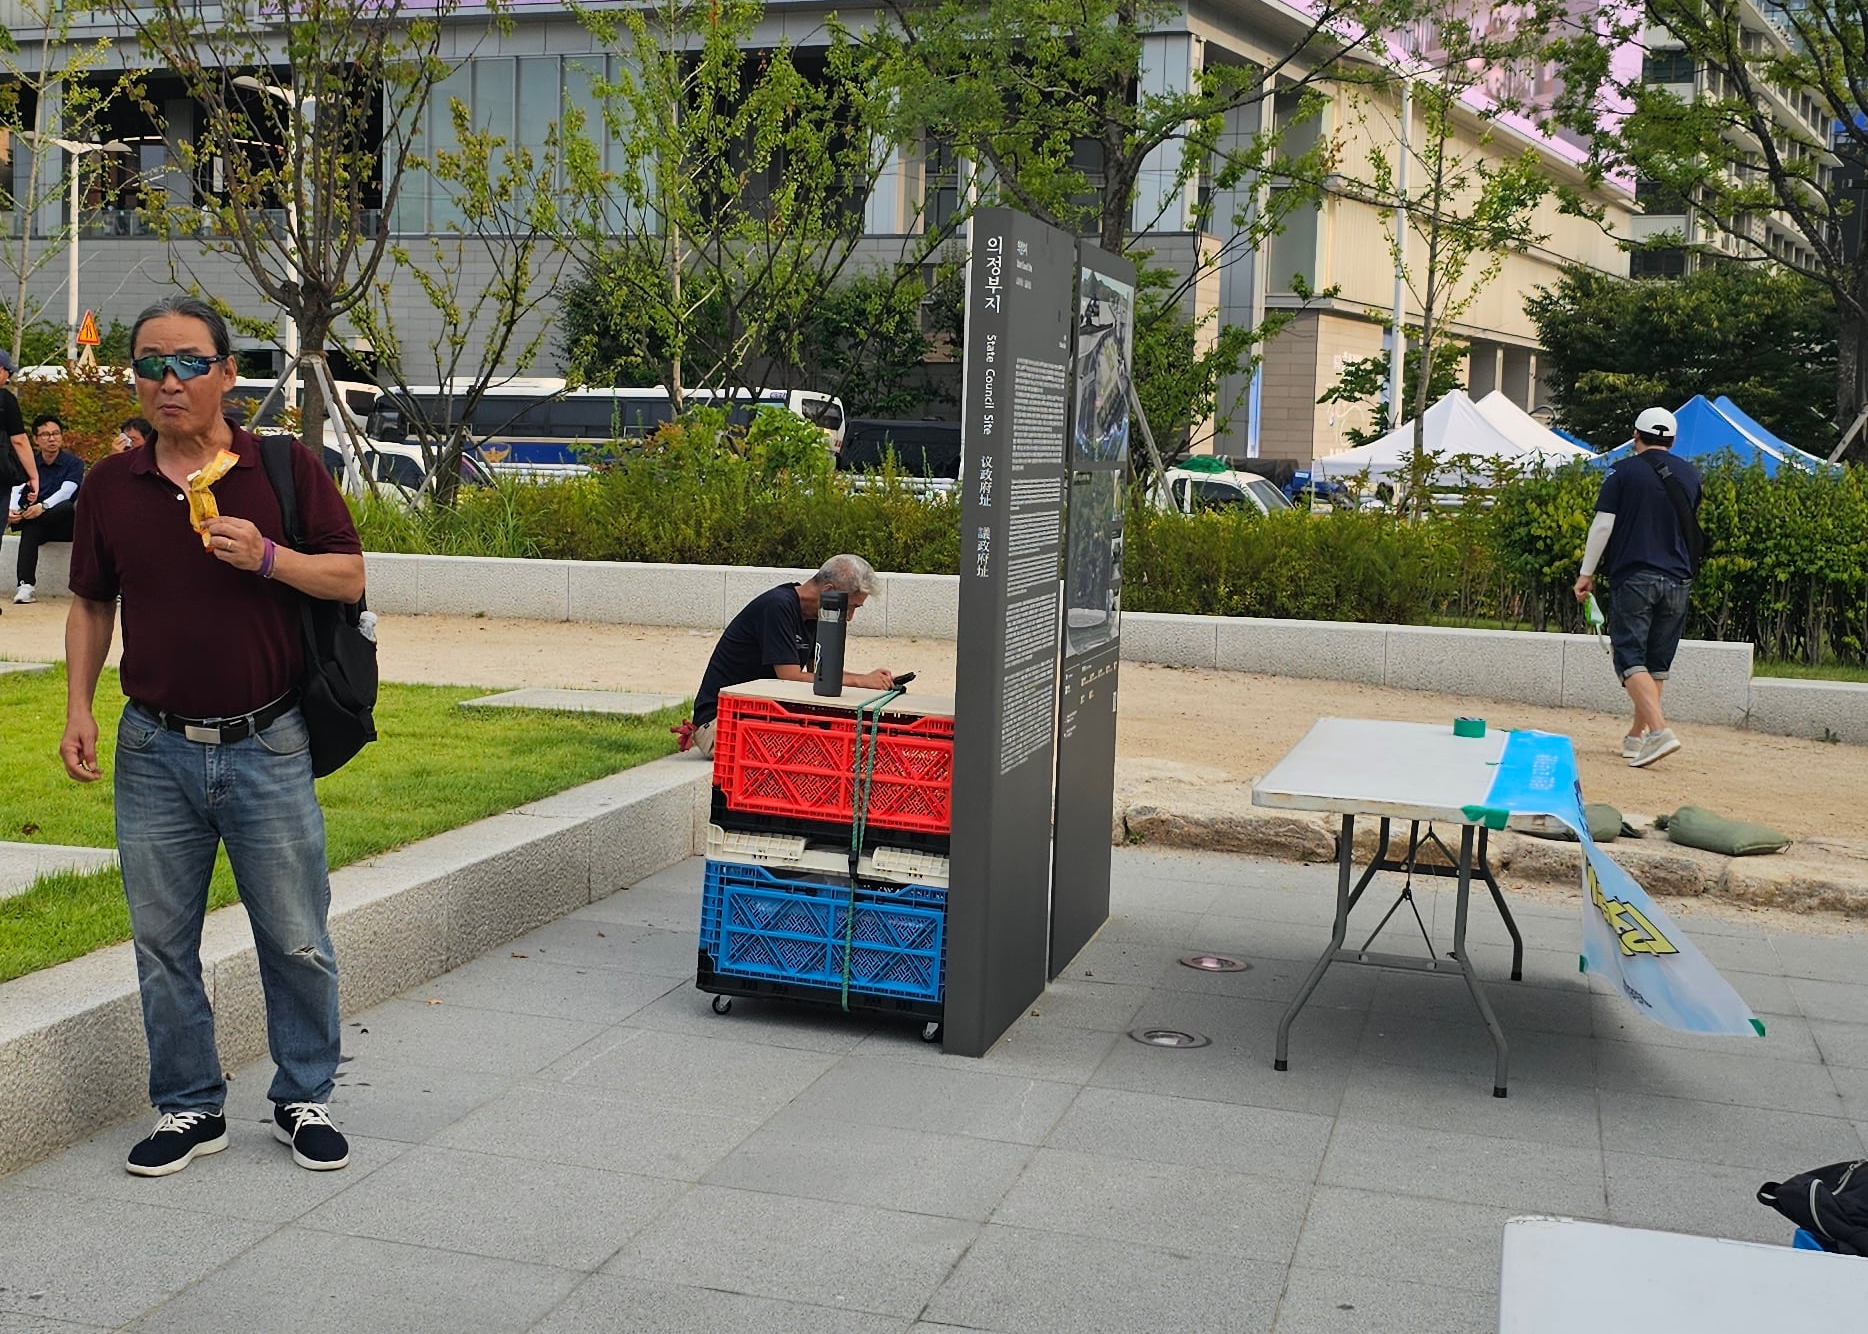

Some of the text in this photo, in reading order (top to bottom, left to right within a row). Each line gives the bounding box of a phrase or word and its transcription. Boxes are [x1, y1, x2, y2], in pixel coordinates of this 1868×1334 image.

[984, 236, 1003, 314] 의정부지
[983, 334, 997, 435] State Council Site
